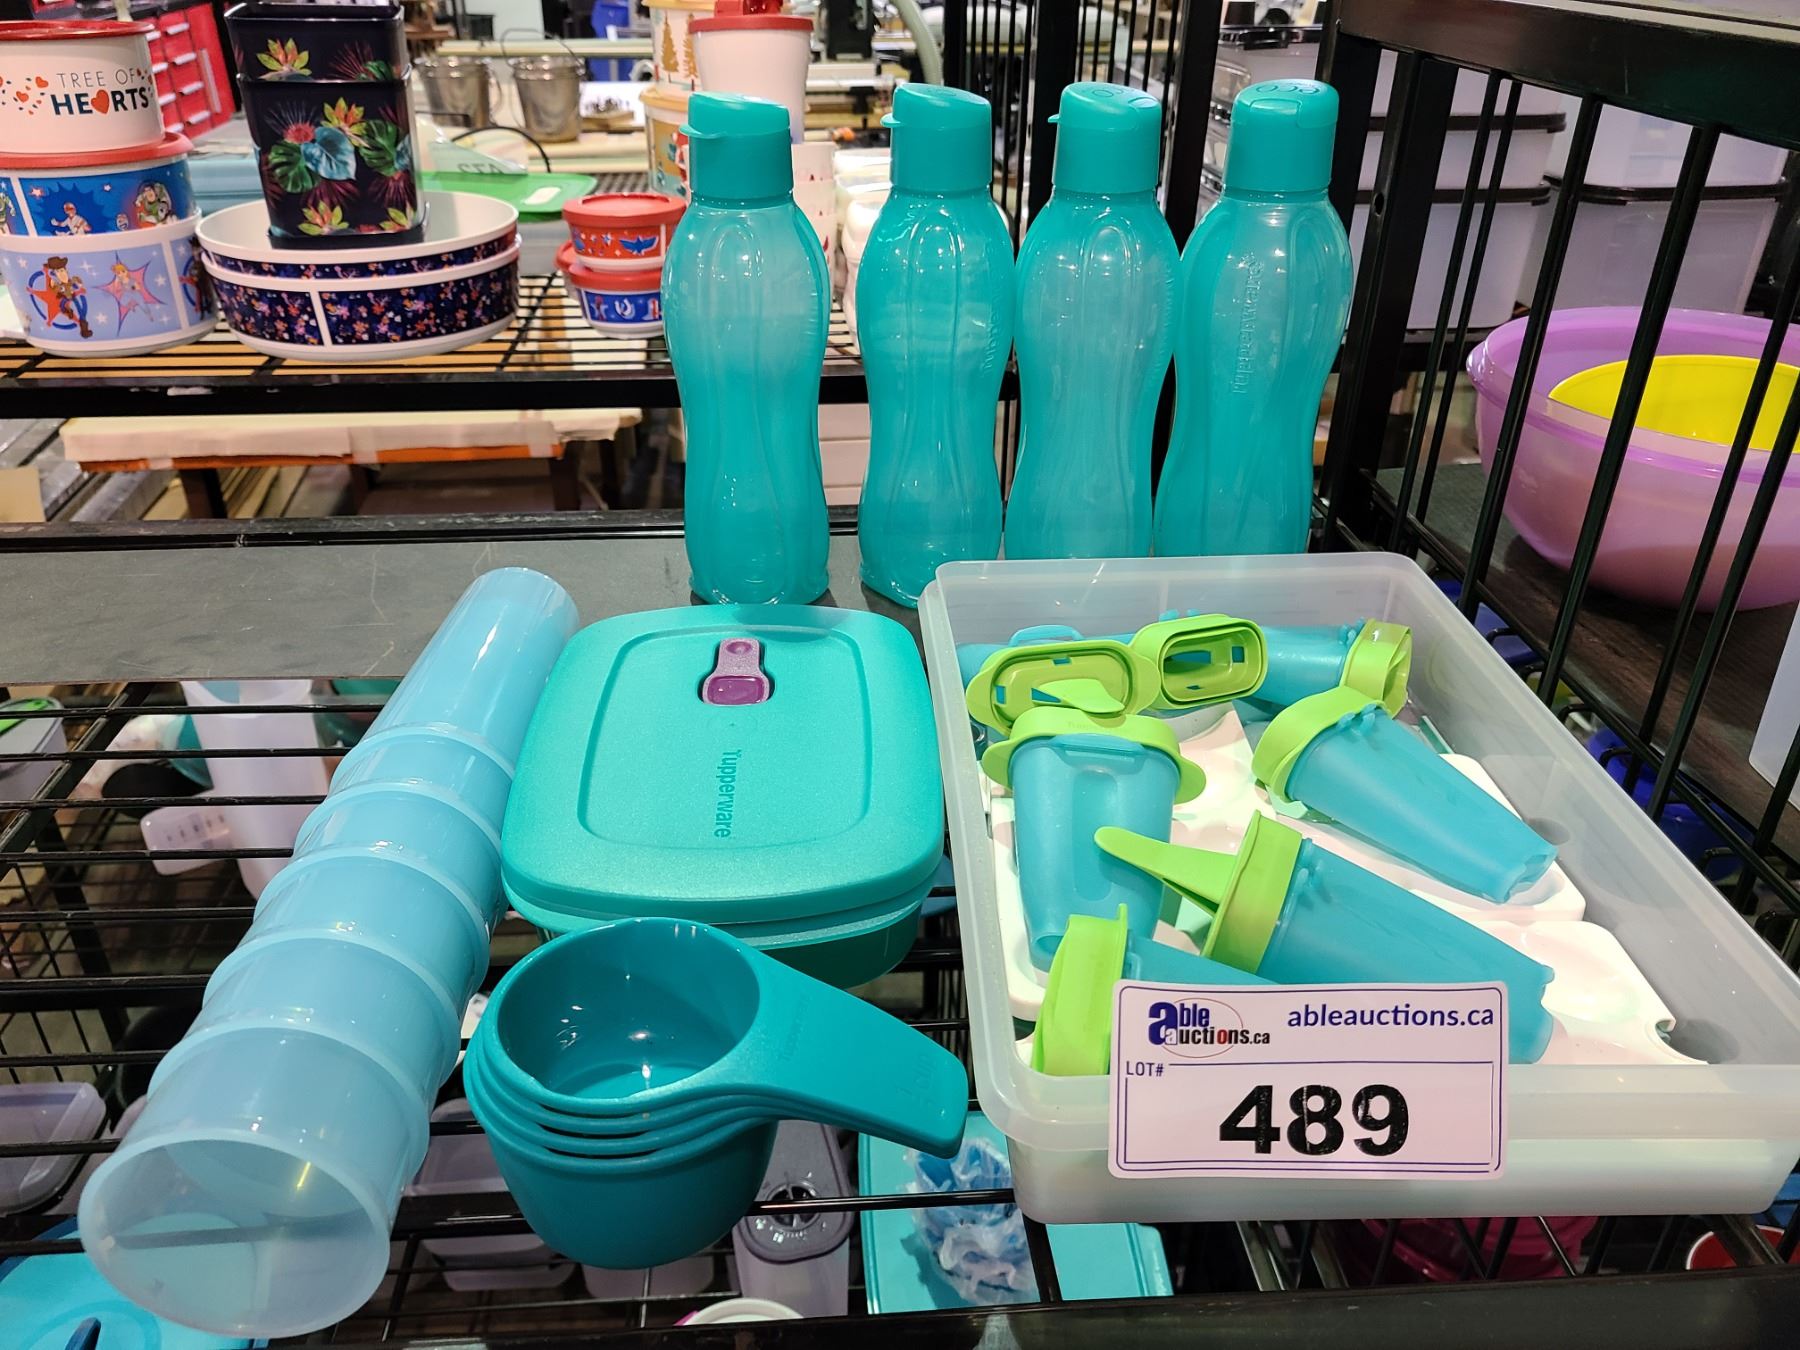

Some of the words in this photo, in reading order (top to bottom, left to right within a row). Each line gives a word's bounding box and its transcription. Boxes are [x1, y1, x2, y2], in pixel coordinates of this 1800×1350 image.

[56, 71, 107, 89] TREE
[115, 68, 136, 86] OF
[713, 749, 742, 839] Tupperware
[1148, 1001, 1210, 1045] able
[1287, 1003, 1495, 1027] ableauctions.ca
[1125, 1060, 1164, 1077] LOT#
[1218, 1083, 1410, 1157] 489
